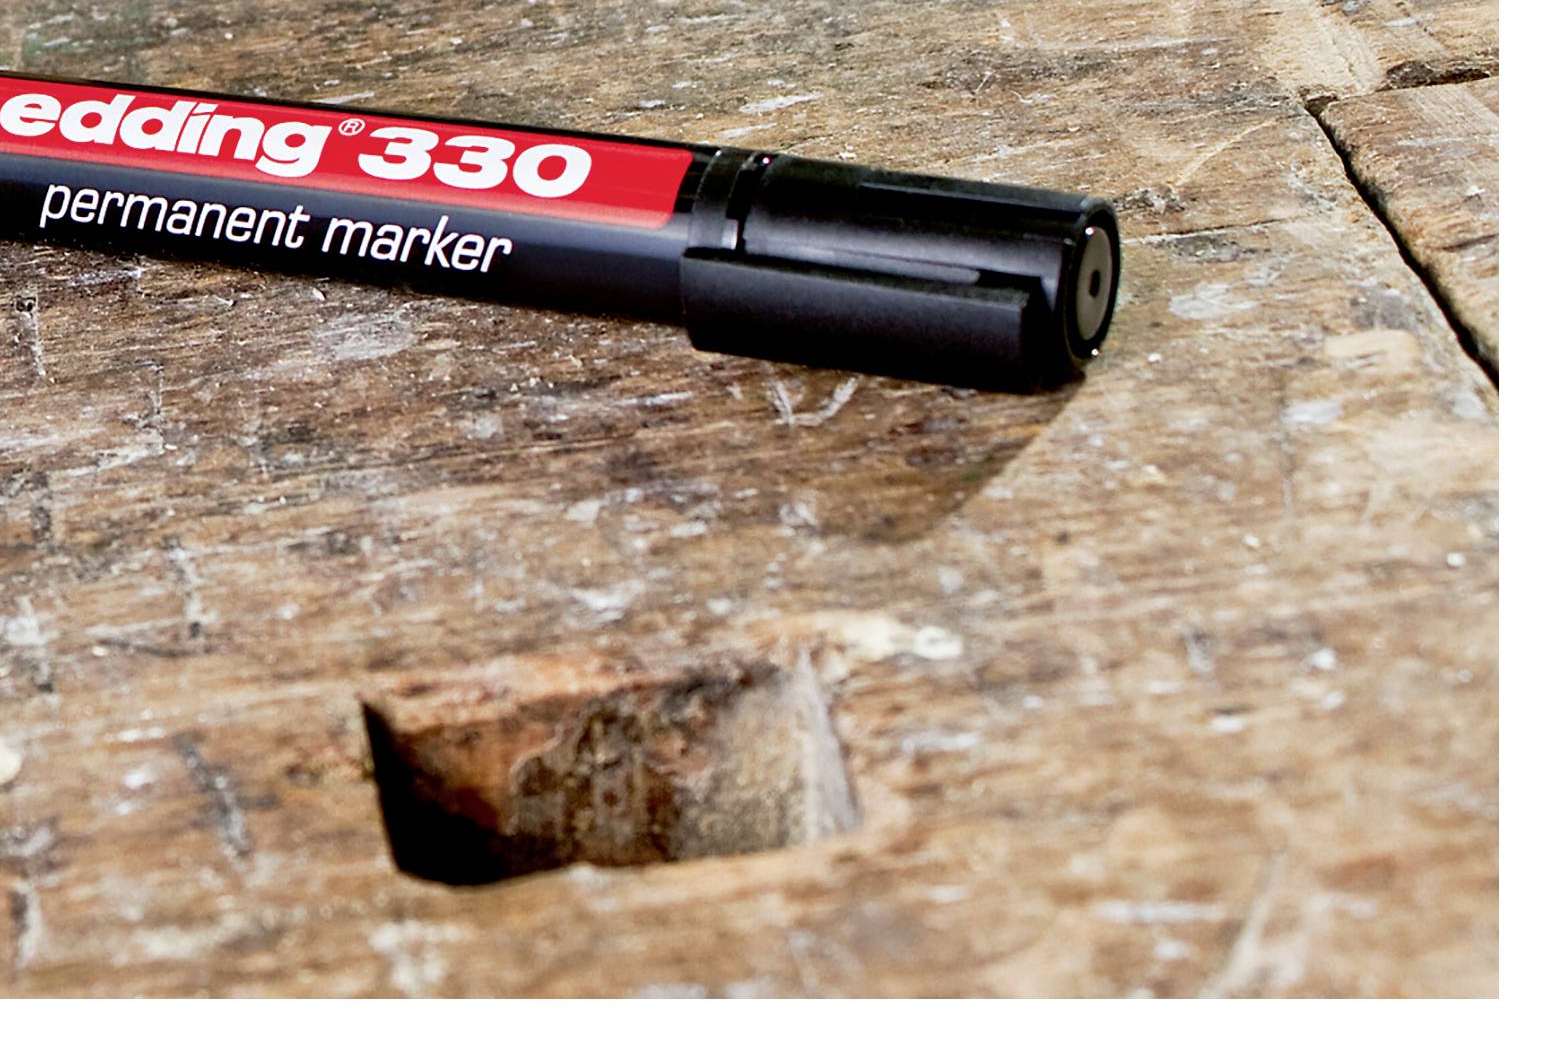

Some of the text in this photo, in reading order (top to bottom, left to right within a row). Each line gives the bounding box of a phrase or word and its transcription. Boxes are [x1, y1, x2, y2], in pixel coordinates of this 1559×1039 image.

[357, 126, 592, 198] 330
[39, 183, 513, 274] permanent marker
